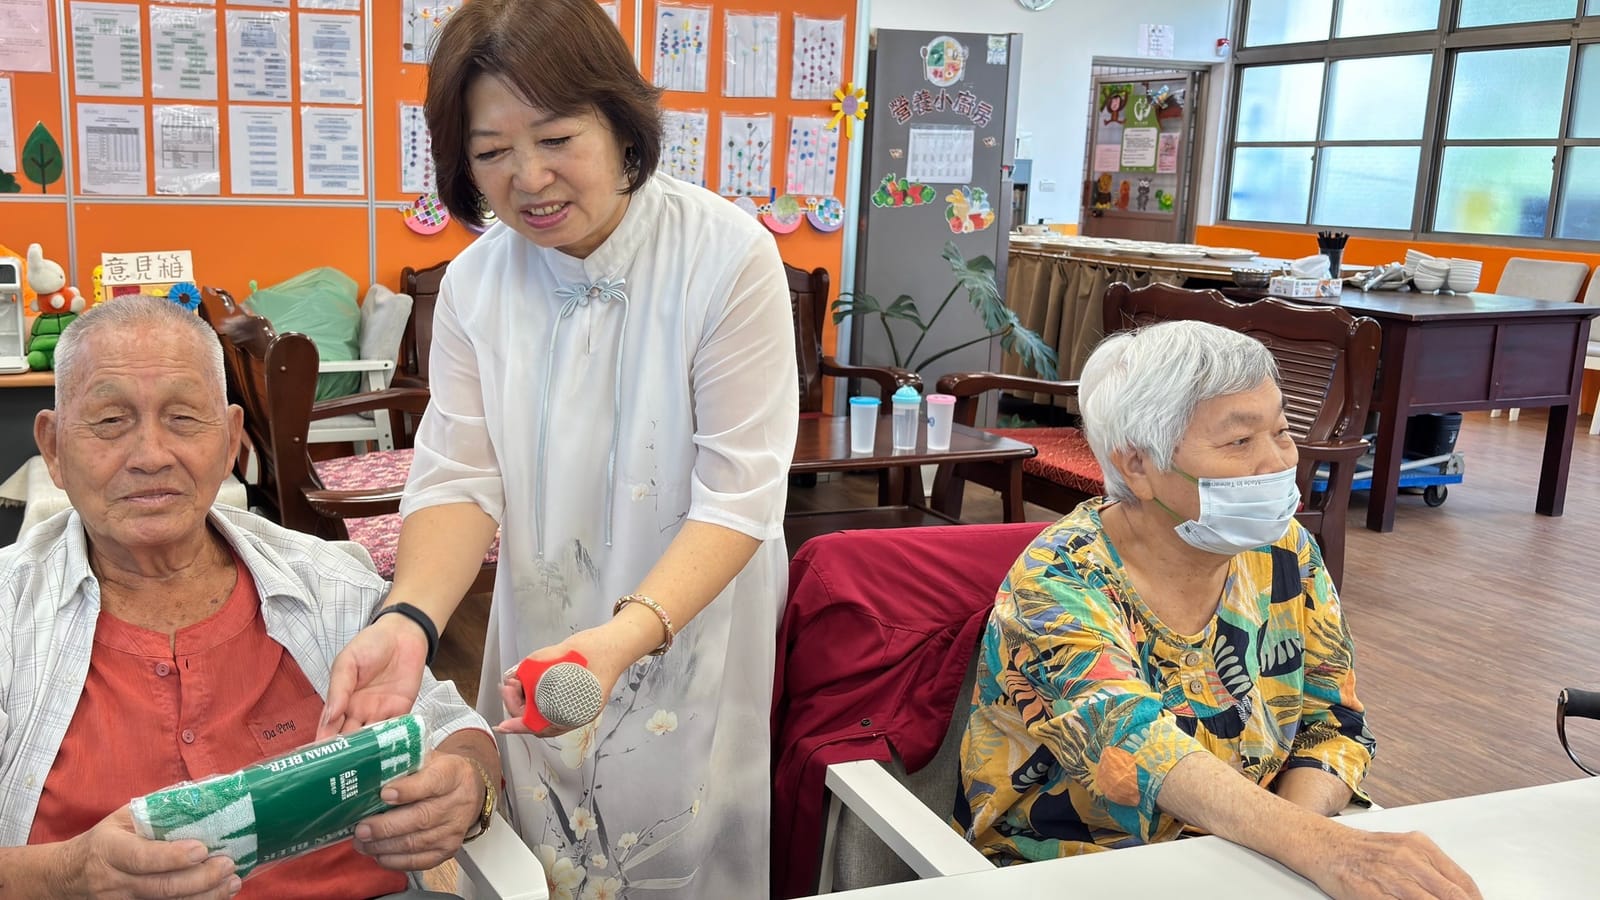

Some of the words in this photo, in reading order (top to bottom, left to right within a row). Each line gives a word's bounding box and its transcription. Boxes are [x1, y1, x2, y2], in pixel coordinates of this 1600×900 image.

[104, 254, 184, 282] 意見箱
[263, 729, 276, 740] Da
[276, 719, 296, 734] Peng
[305, 736, 351, 760] TAIWAN
[268, 754, 304, 772] BEER
